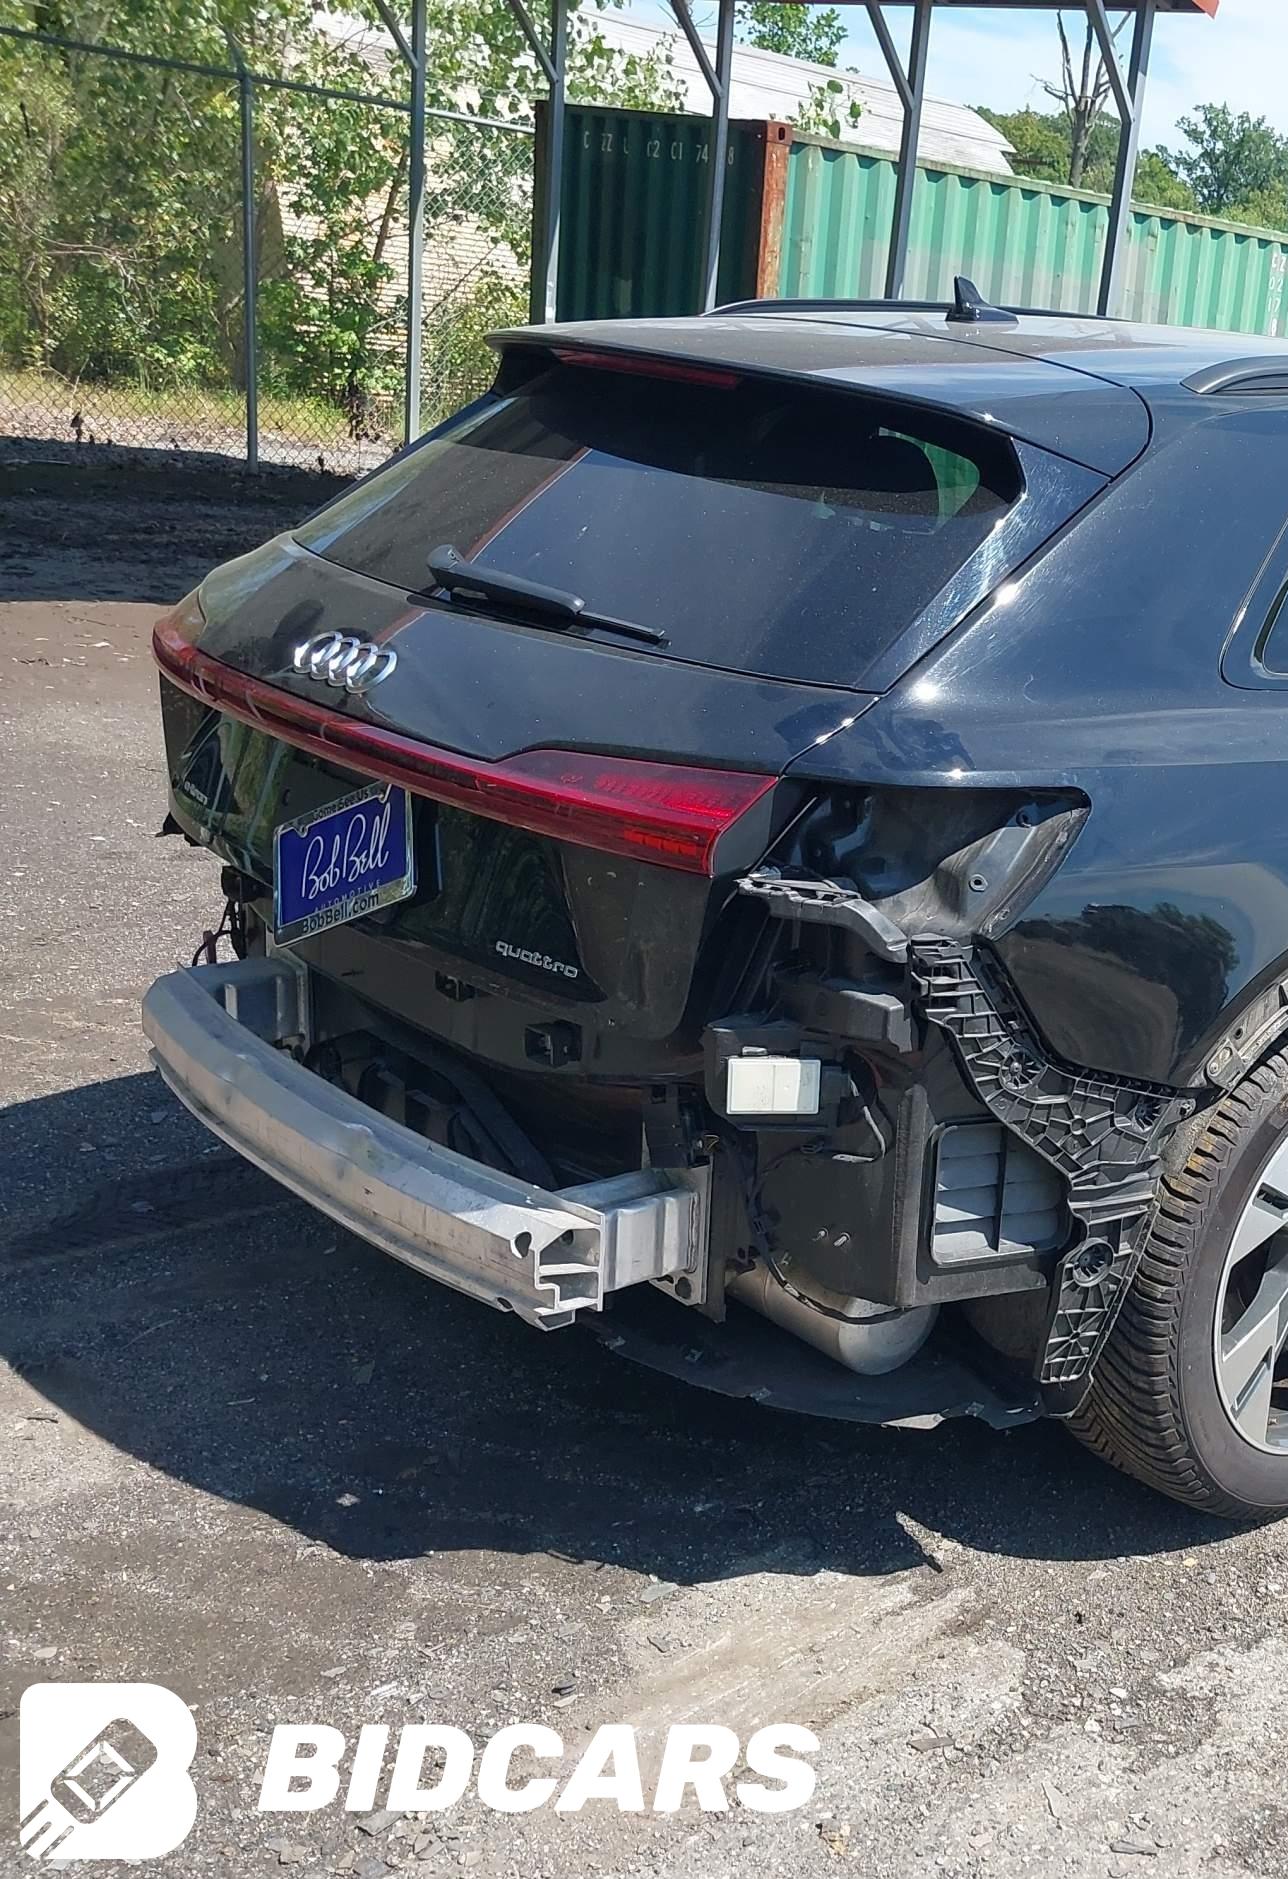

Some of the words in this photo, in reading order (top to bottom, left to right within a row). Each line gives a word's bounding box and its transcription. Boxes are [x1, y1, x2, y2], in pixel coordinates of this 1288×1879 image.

[301, 834, 342, 900] Bob
[342, 802, 391, 882] Bell
[302, 893, 379, 934] BobBell.com
[495, 940, 579, 978] quattro
